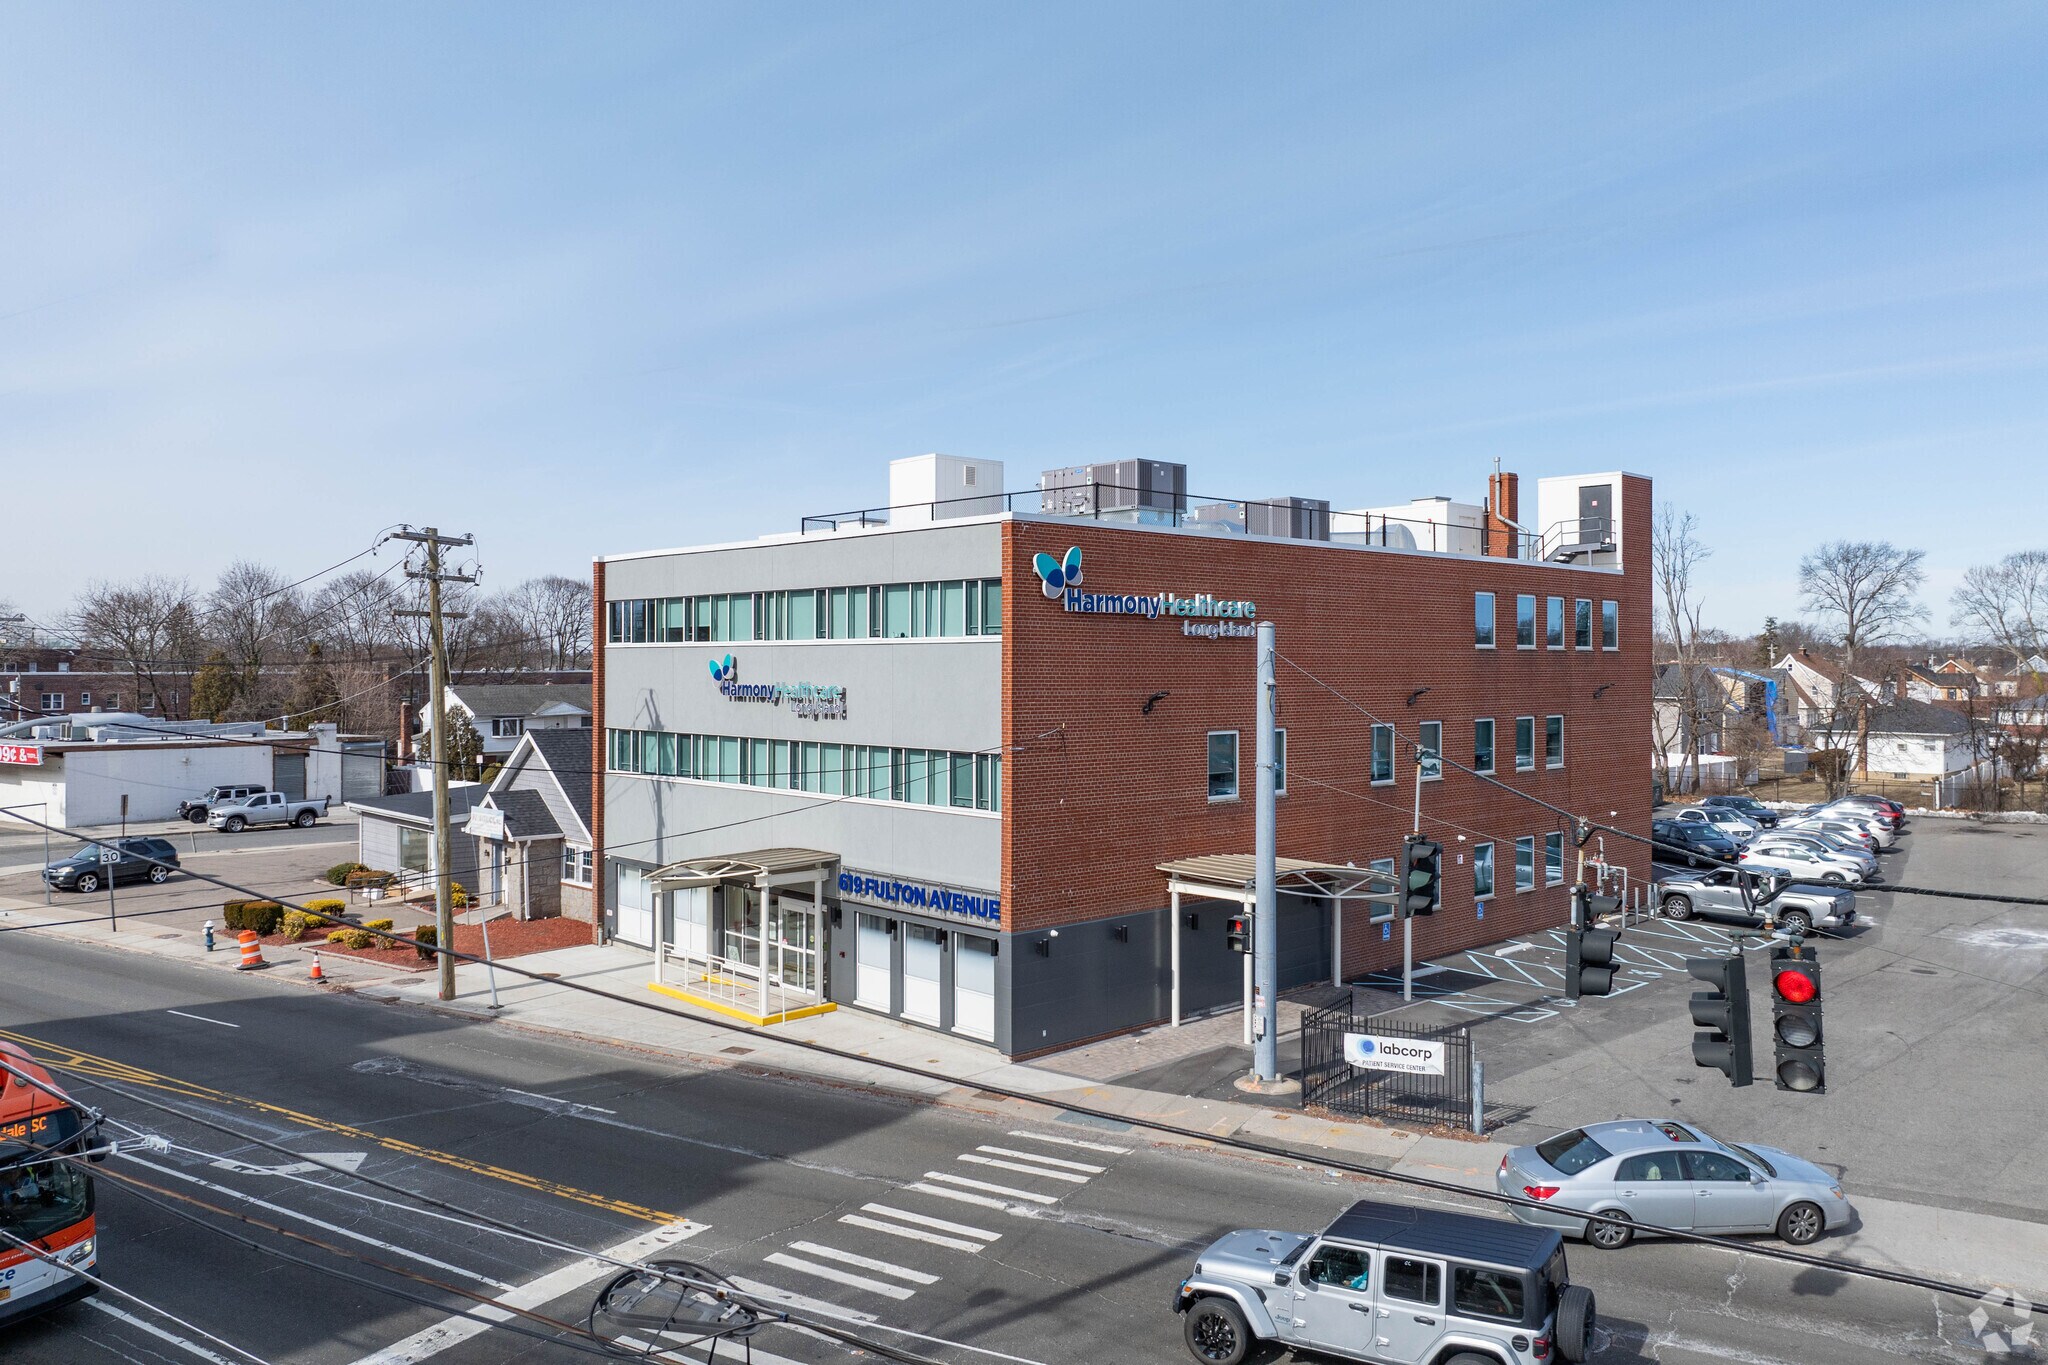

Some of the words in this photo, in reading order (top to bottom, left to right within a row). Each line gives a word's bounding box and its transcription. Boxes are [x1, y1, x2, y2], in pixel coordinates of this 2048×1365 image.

[1183, 620, 1218, 640] Long
[1219, 621, 1257, 638] Island
[791, 702, 814, 714] Long
[815, 703, 844, 714] Island
[102, 851, 119, 862] 30
[838, 873, 863, 894] 619
[864, 878, 926, 907] FULTON
[928, 890, 1001, 920] AVENUE
[1379, 1042, 1432, 1061] labcorp
[1384, 1061, 1405, 1069] SERVICE
[1406, 1064, 1426, 1072] CENTER
[31, 1116, 47, 1133] SC
